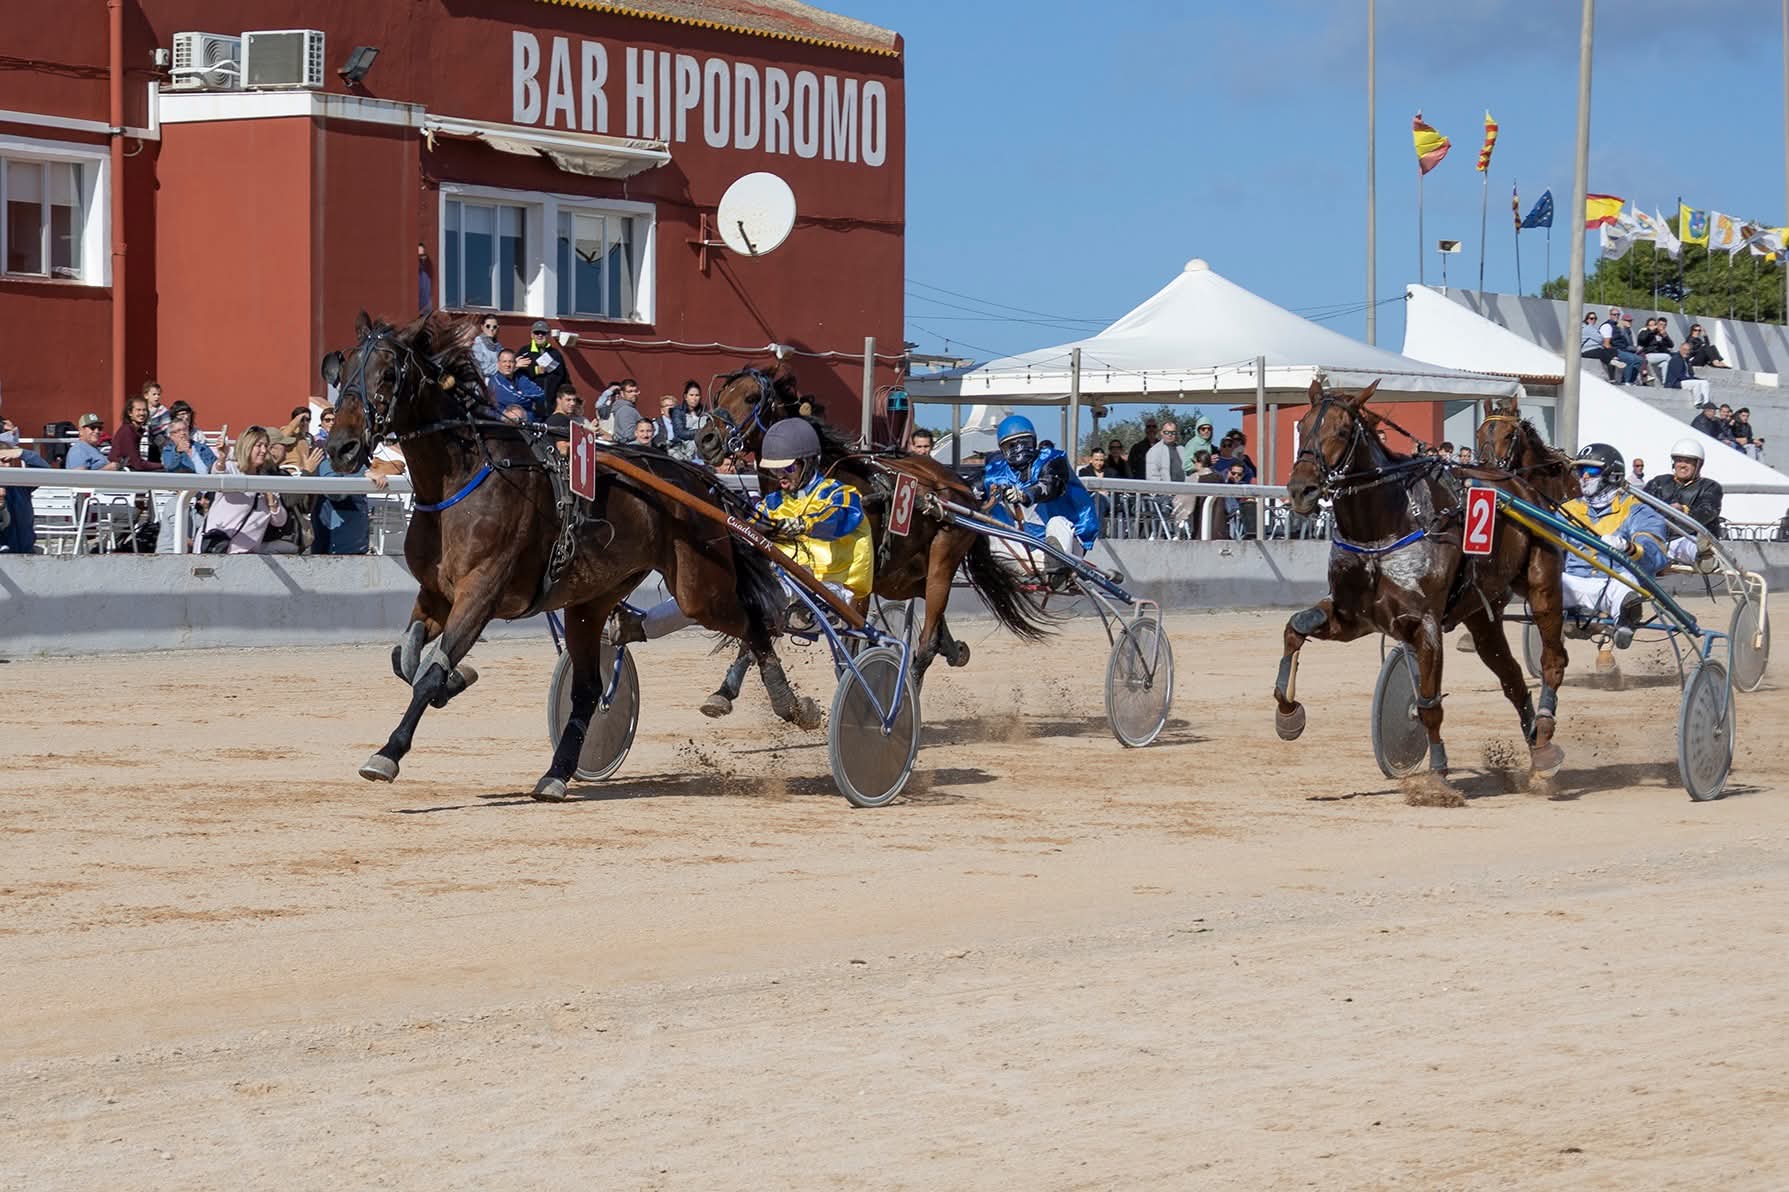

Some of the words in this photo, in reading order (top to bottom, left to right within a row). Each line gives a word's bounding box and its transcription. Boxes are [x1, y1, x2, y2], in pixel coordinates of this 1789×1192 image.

[512, 30, 608, 134] BAR
[625, 46, 887, 167] HIPODROMO
[576, 437, 587, 487] 1
[896, 485, 911, 525] 3
[1470, 498, 1490, 544] 2
[727, 515, 759, 543] Cuadras
